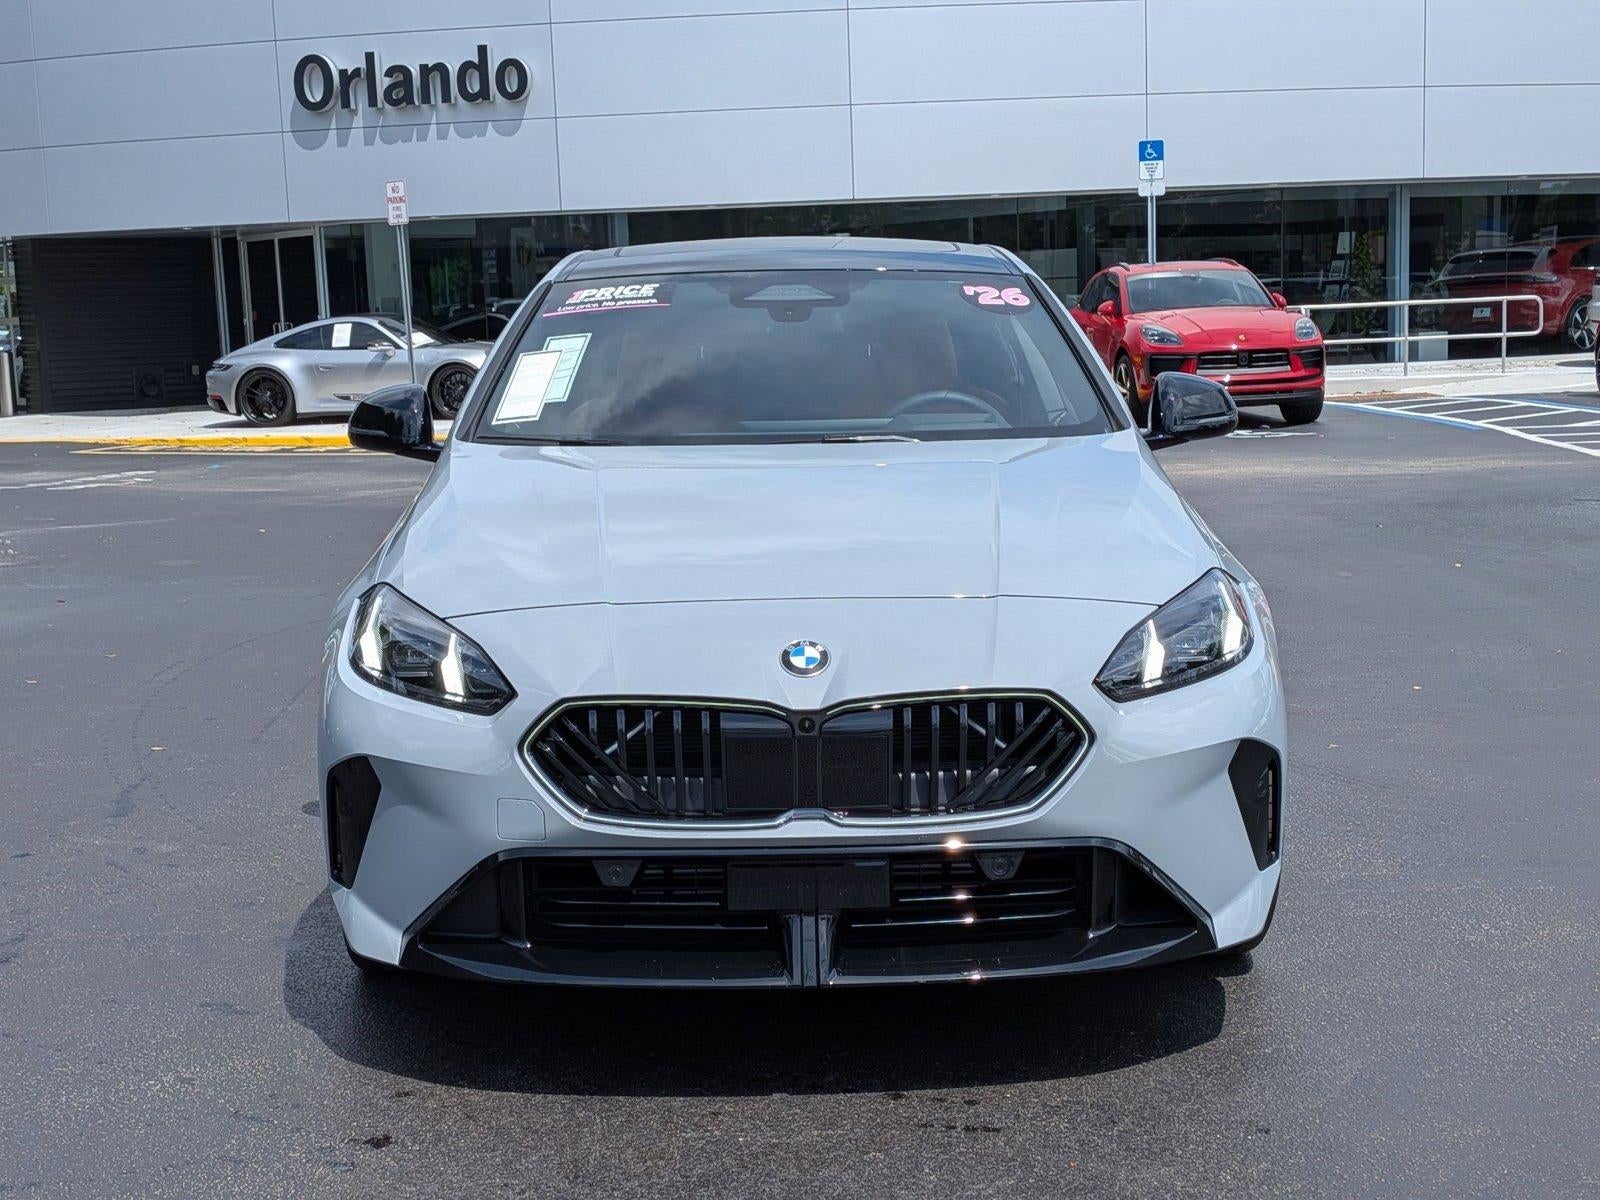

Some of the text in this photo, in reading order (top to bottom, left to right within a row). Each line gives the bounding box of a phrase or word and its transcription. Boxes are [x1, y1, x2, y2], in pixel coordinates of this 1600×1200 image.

[293, 44, 531, 113] Orlando
[391, 184, 400, 194] NO
[387, 196, 407, 204] PARKING
